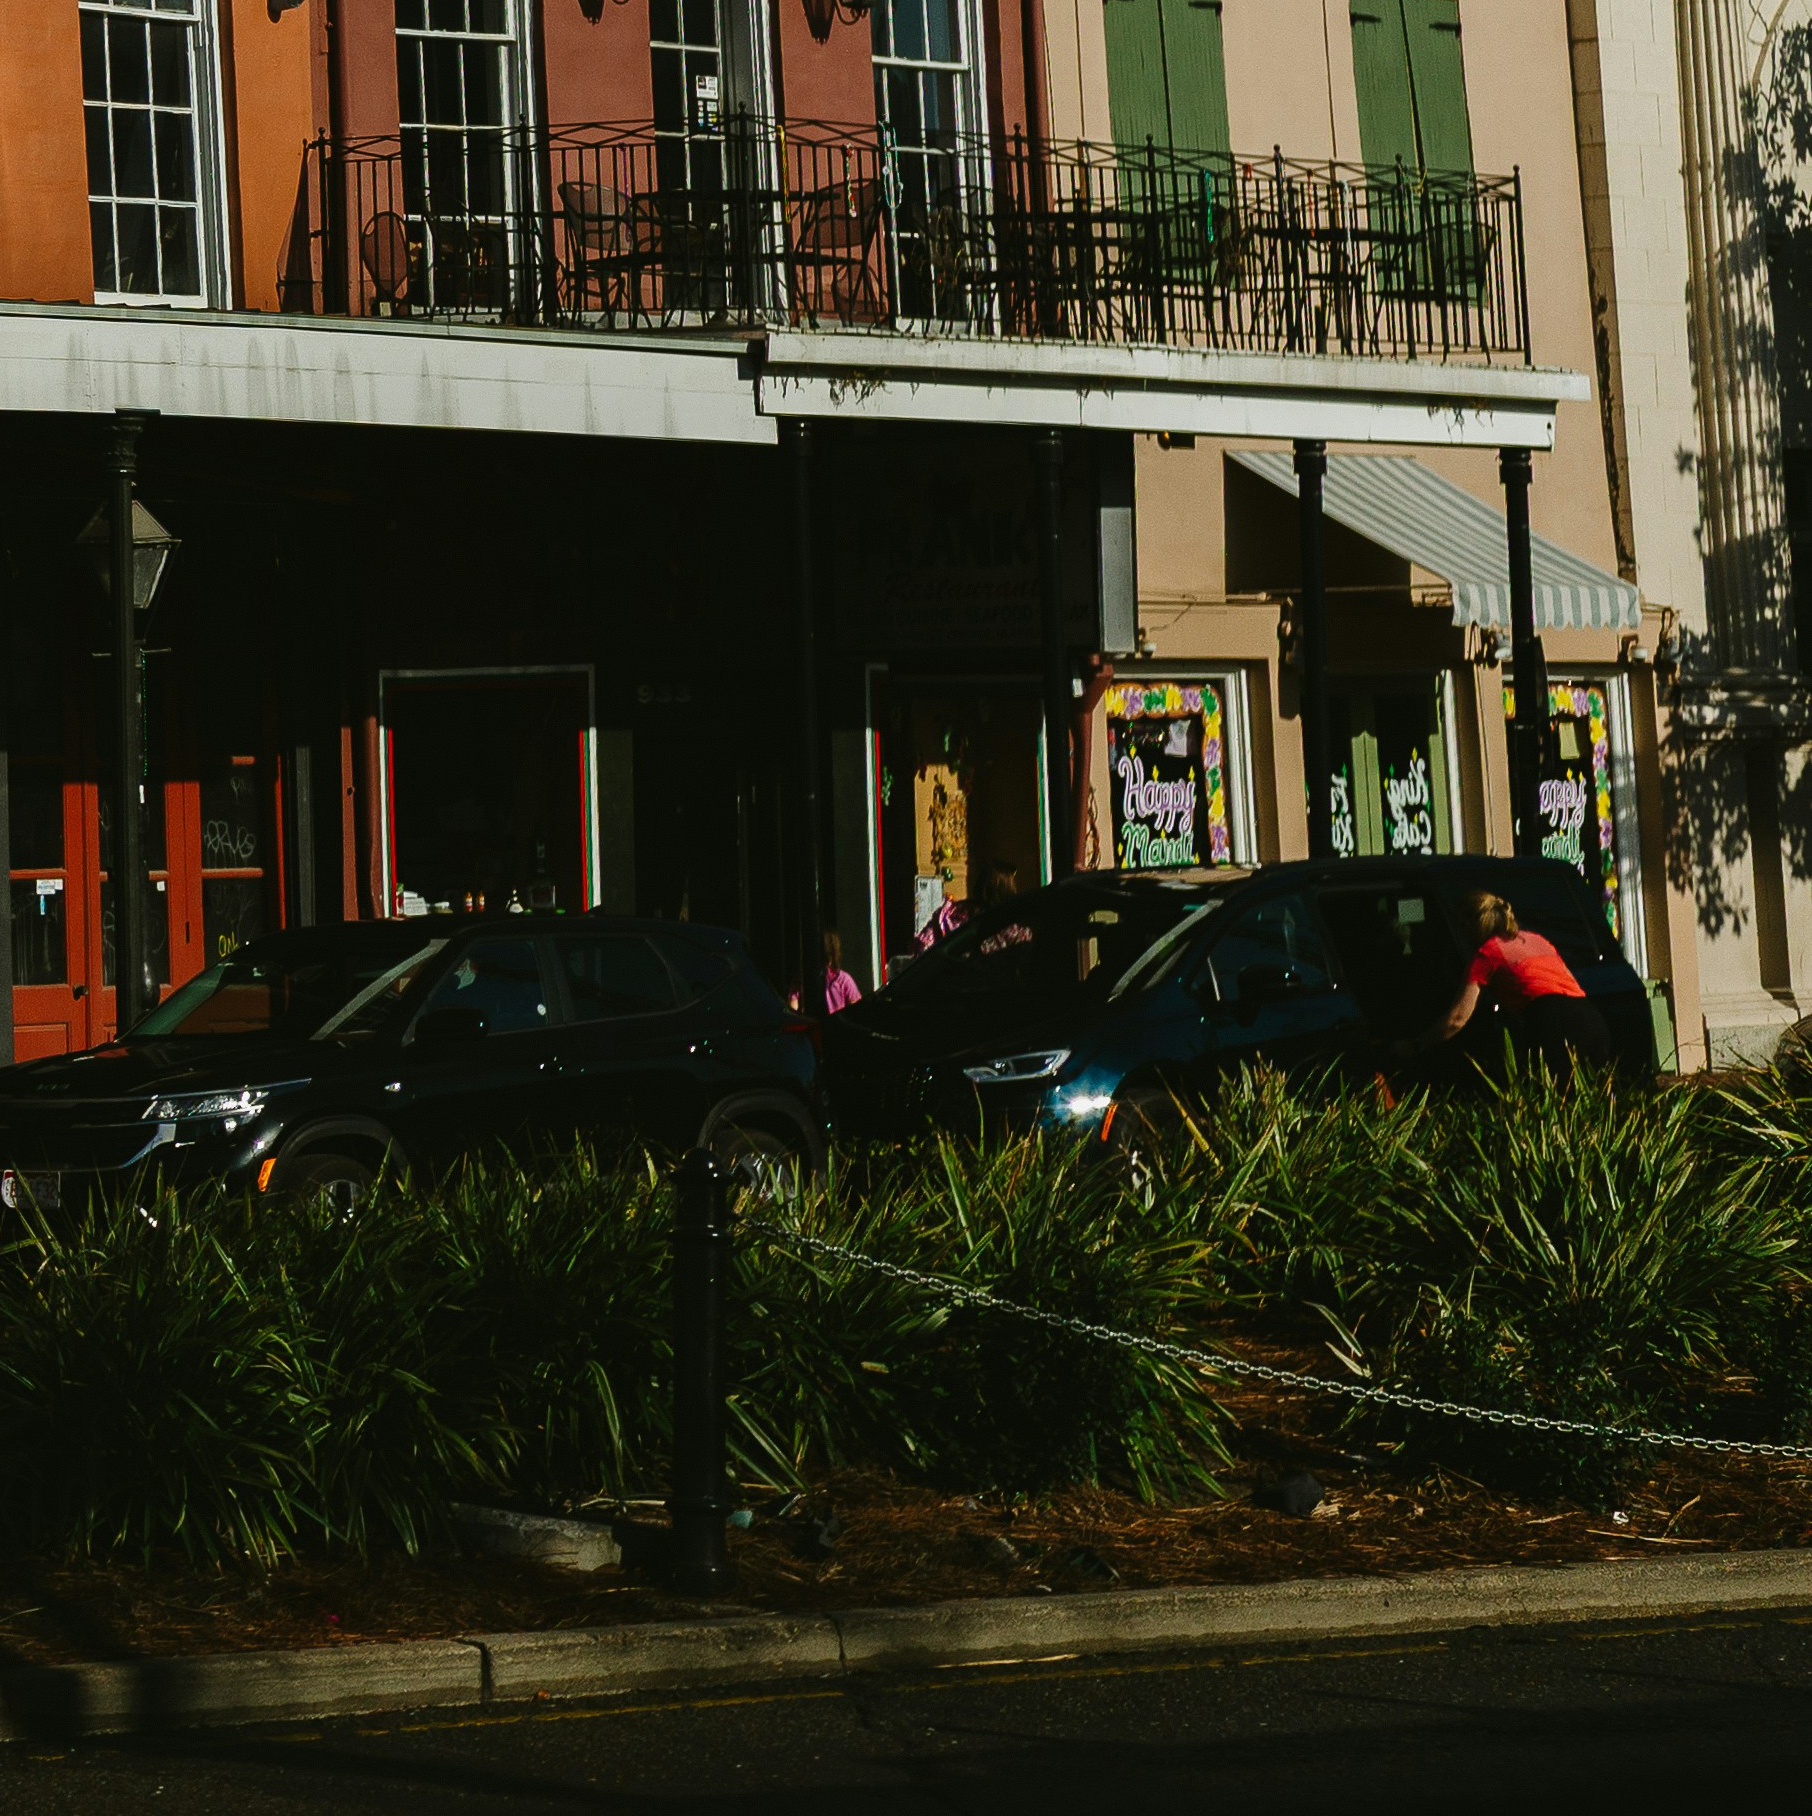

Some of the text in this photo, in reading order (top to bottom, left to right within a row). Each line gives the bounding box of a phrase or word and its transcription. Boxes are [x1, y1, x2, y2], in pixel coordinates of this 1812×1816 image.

[1118, 755, 1197, 835] Happy
[1539, 778, 1587, 830] appy
[1121, 820, 1195, 868] Mardi
[1542, 819, 1586, 865] ardi
